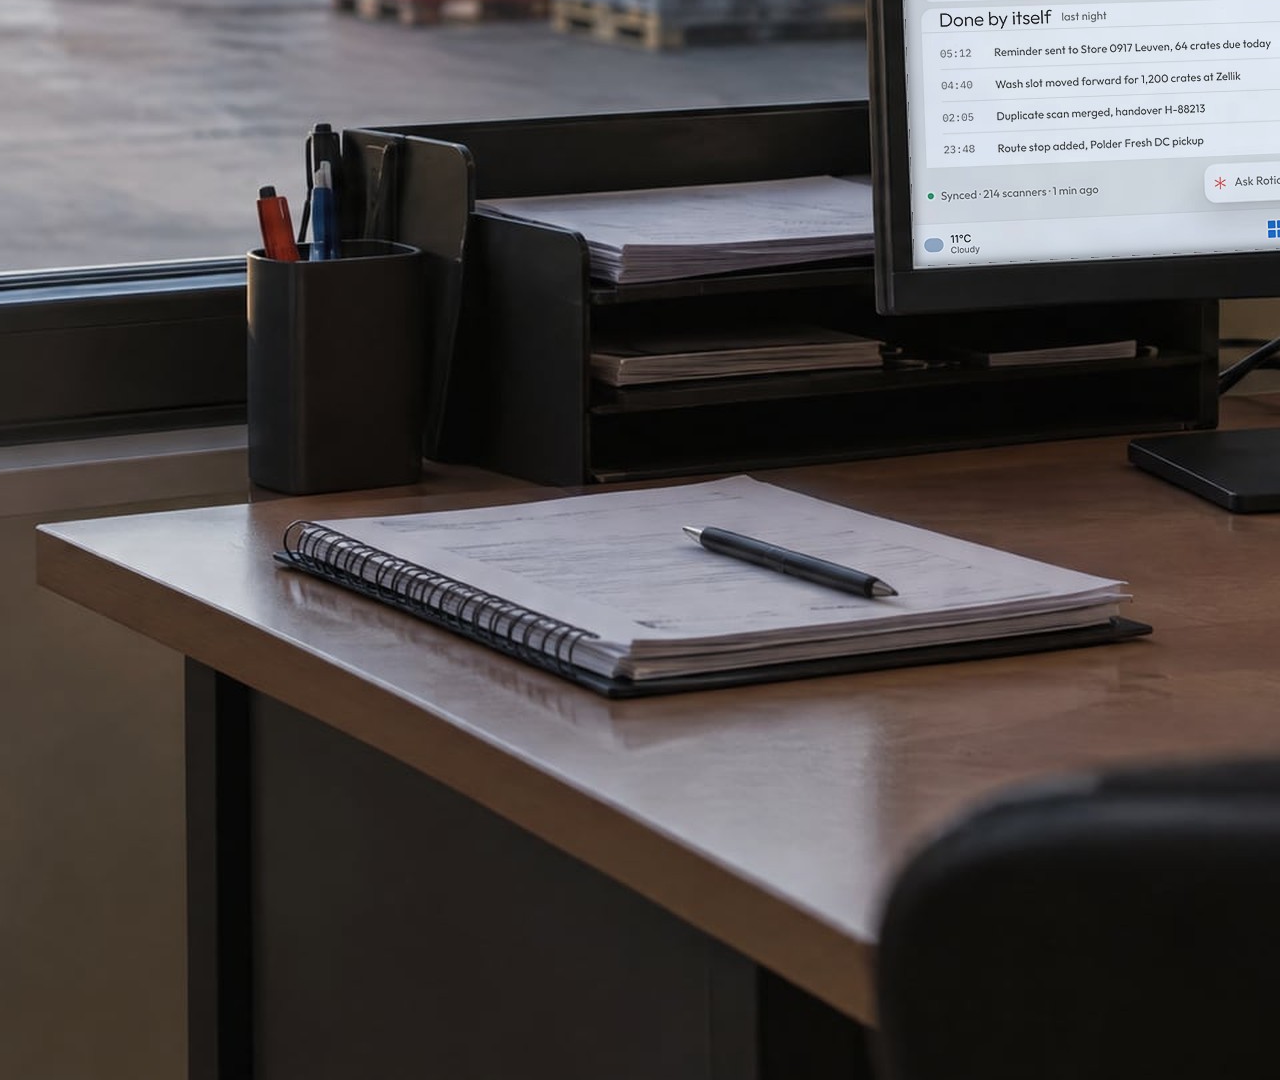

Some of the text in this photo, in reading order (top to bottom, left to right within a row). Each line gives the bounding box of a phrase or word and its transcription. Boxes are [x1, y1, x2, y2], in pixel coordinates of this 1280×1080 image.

[939, 9, 1052, 30] Done by itself
[1061, 10, 1107, 23] last night
[939, 48, 972, 59] 05:12
[994, 38, 1271, 57] Reminder sent to Store 0917 Leuven, 64 crates due today
[942, 112, 974, 123] 02:05
[996, 103, 1206, 122] Duplicate scan merged, handover H-88213
[943, 144, 975, 154] 23:48
[997, 136, 1204, 153] Route stop added, Polder Fresh DC pickup
[940, 186, 1099, 203] Synced 214 scanners 1 min ago
[950, 233, 971, 243] 11°C
[950, 245, 980, 255] Cloudy
